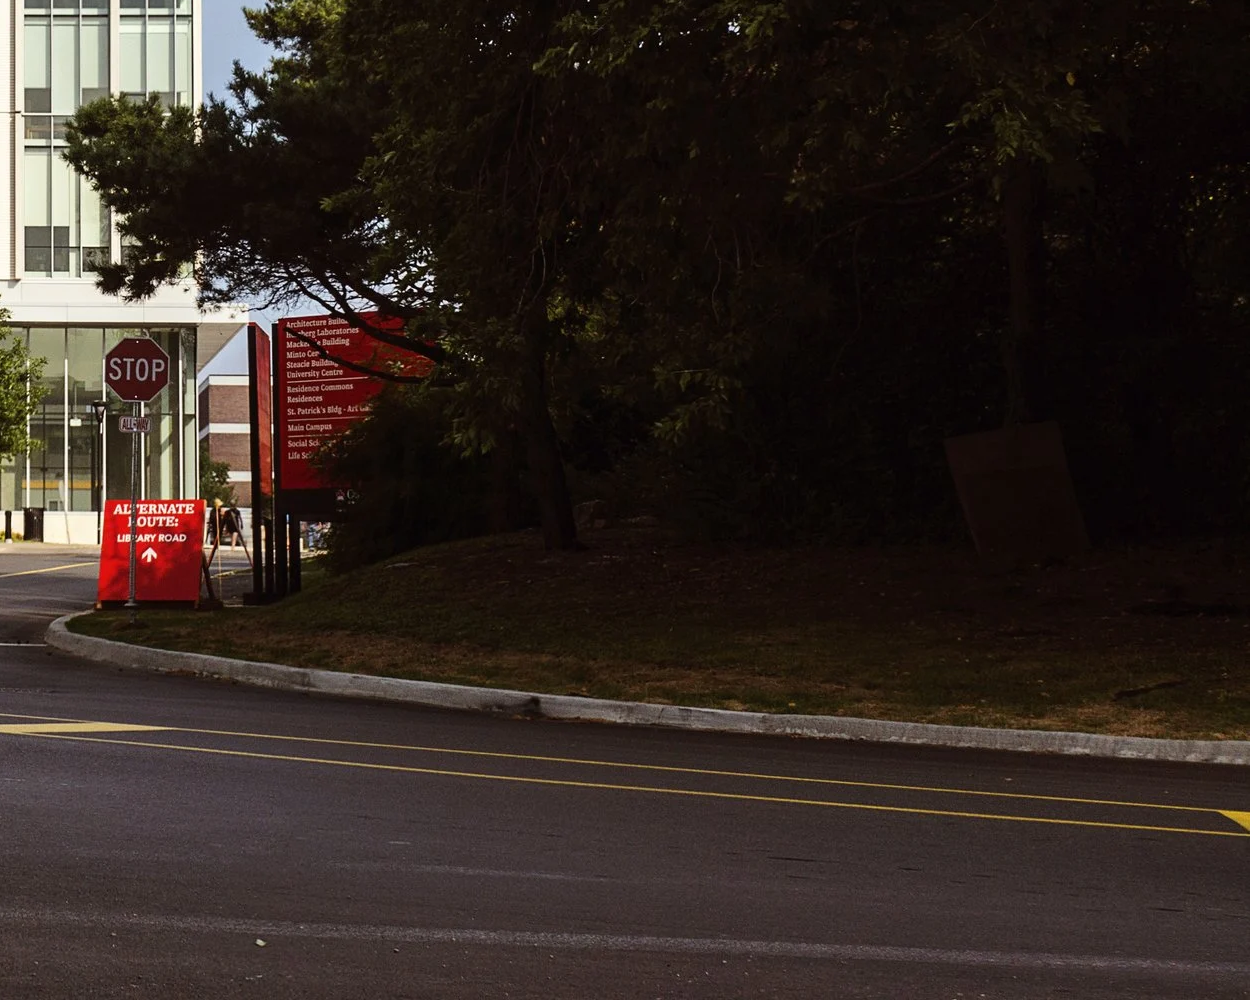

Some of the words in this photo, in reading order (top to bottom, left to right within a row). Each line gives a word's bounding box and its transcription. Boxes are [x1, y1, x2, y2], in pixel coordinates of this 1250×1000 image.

[286, 320, 327, 328] Architecture
[317, 327, 359, 336] Laboratories
[322, 338, 350, 346] Building
[109, 358, 165, 381] STOP
[286, 370, 320, 378] University
[287, 385, 320, 393] Residence
[287, 395, 323, 403] Residences
[297, 405, 326, 414] Patrick's
[306, 423, 332, 432] Campus
[288, 439, 307, 447] Social
[117, 534, 156, 542] LIBARY
[158, 534, 186, 542] ROAD
